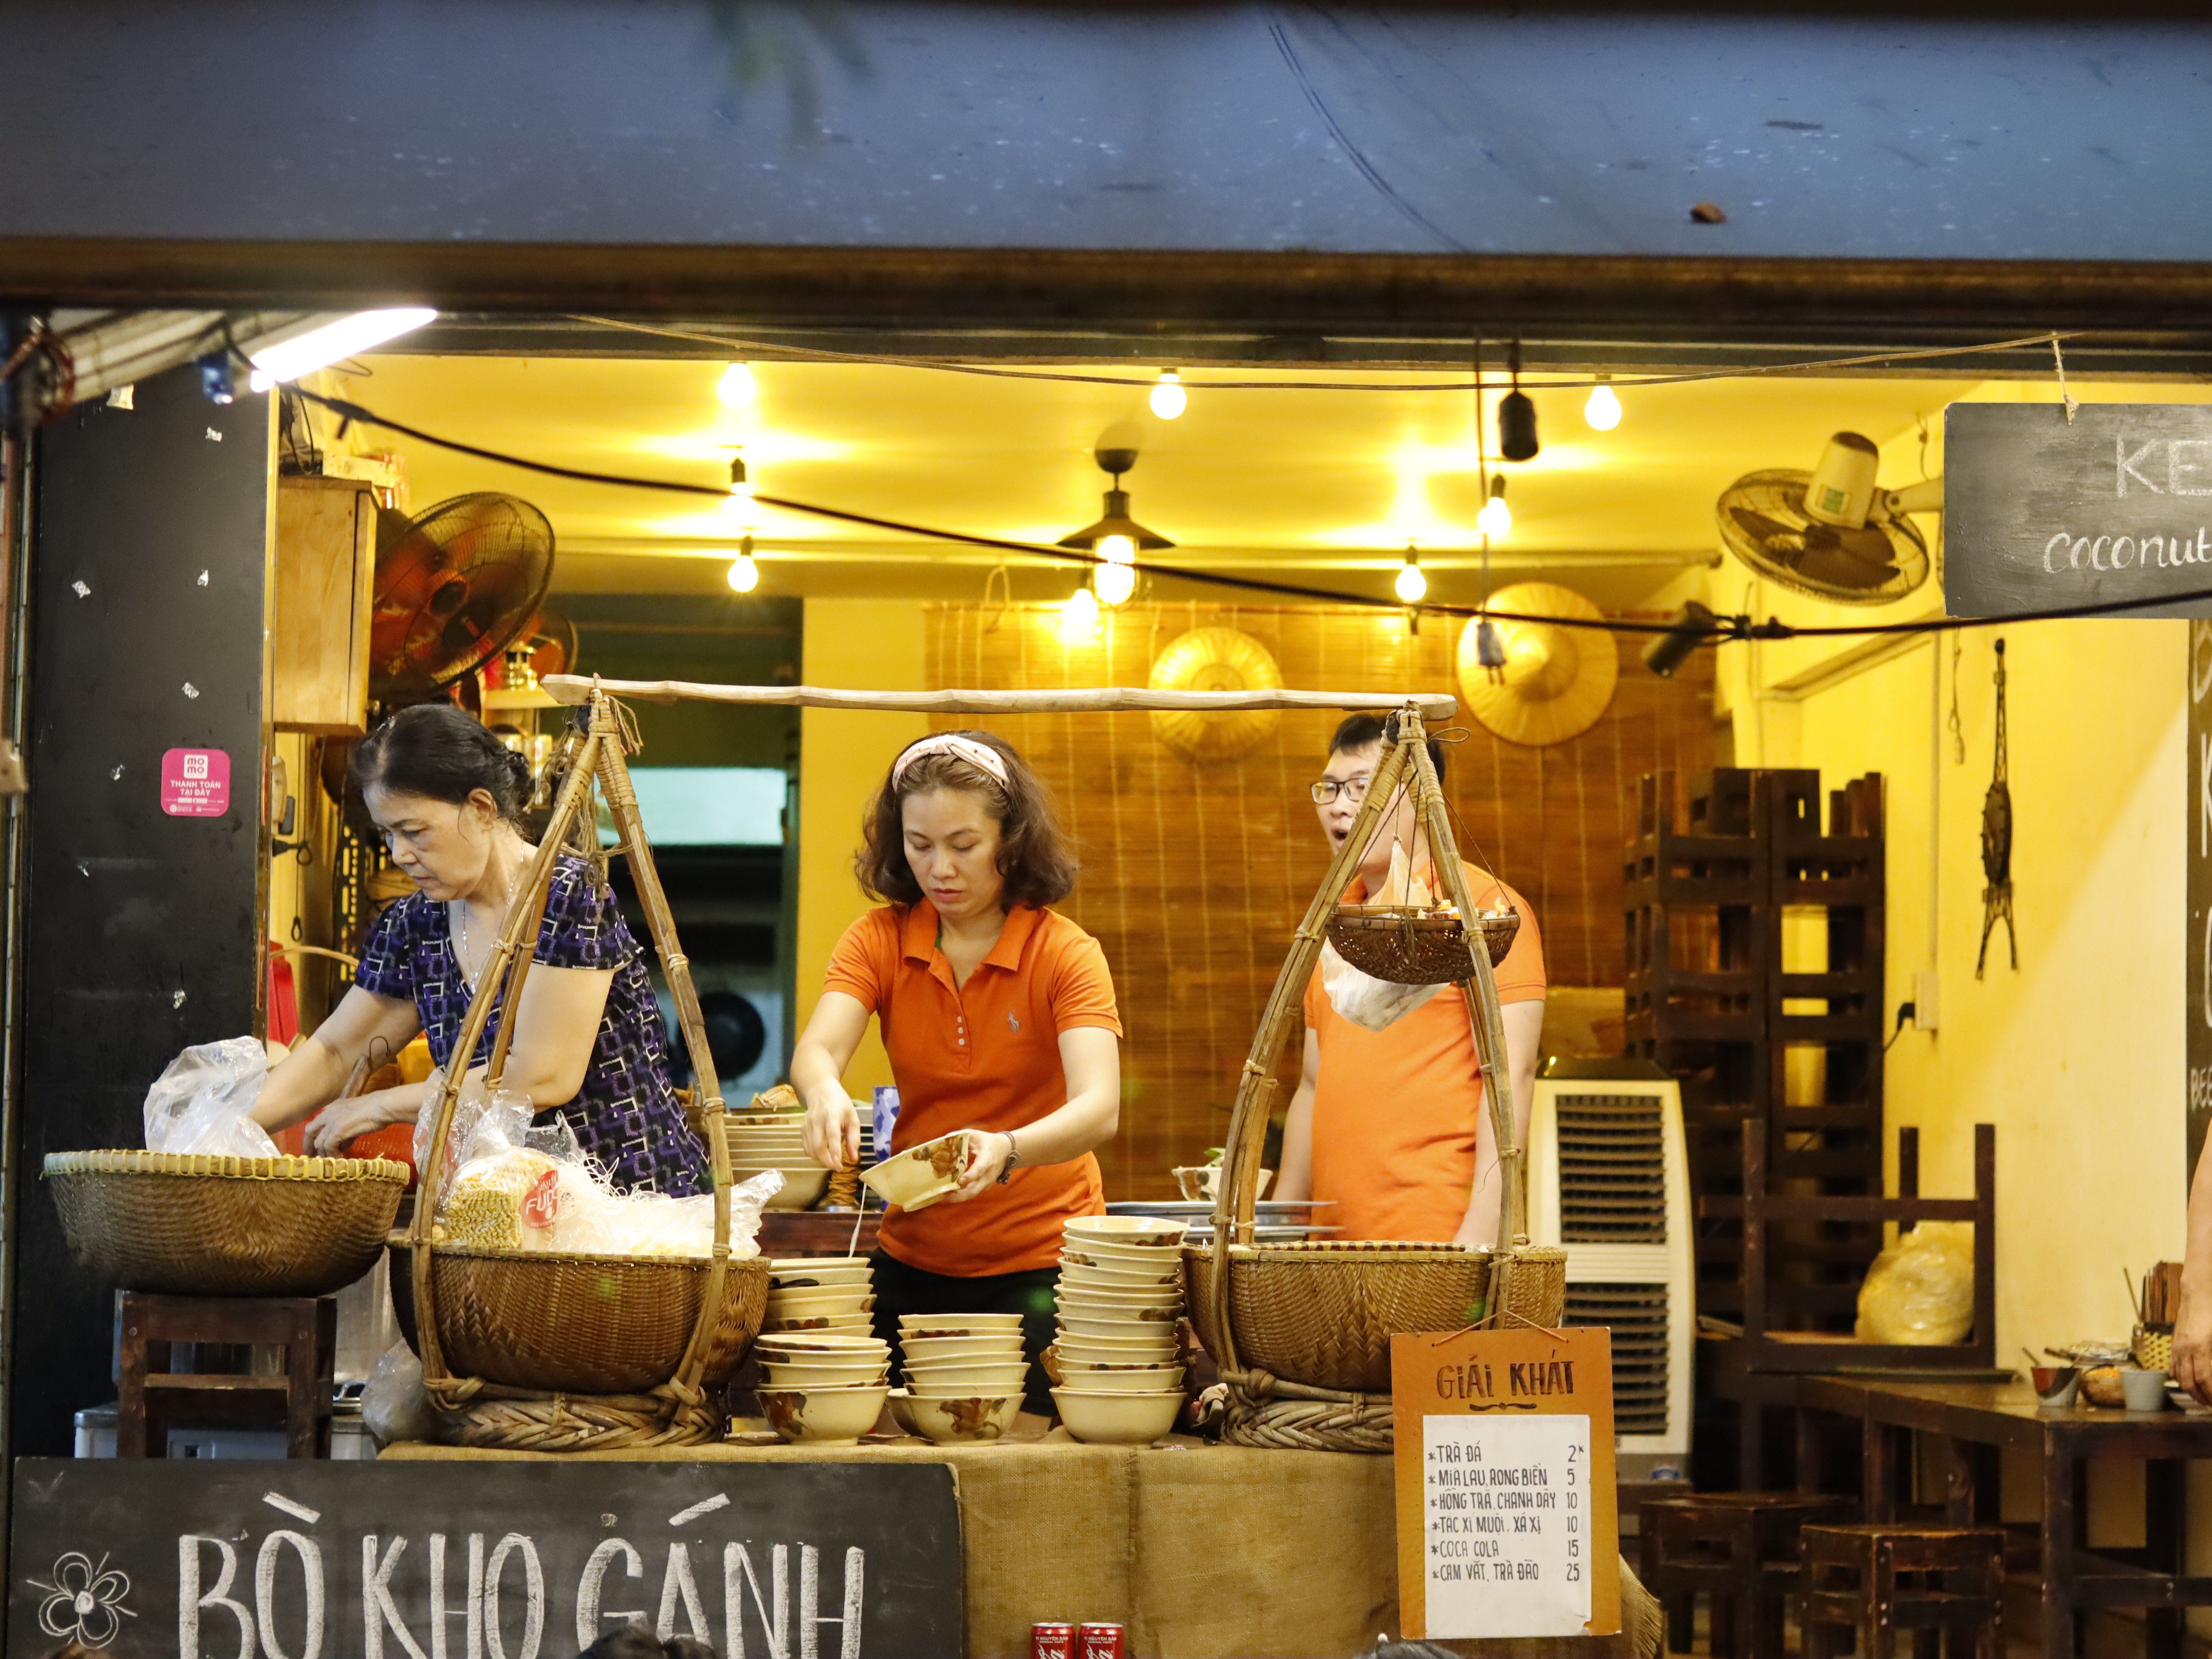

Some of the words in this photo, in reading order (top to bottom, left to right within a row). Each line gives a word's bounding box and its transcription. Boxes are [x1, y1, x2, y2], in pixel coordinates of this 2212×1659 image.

[199, 781, 221, 789] TOÁN
[1510, 1349, 1575, 1396] KHÁT
[1436, 1441, 1461, 1463] TRÀ
[1466, 1440, 1481, 1462] ĐÁ
[1490, 1468, 1519, 1486] RONG
[1522, 1462, 1547, 1486] BIỂN
[1567, 1468, 1575, 1486] 5
[1439, 1487, 1467, 1510] HỒNG
[1497, 1492, 1533, 1509] CHANH
[1536, 1488, 1556, 1509] DÂY
[1565, 1491, 1578, 1509] 10
[1513, 1512, 1527, 1533] XÁ
[1566, 1516, 1578, 1533] 10
[1440, 1540, 1468, 1558] COCA
[1474, 1540, 1499, 1557] COLA
[1568, 1539, 1578, 1557] 15
[179, 1492, 325, 1659] BÒ
[363, 1532, 545, 1659] KHO
[576, 1493, 865, 1659] GÁNH
[1441, 1564, 1461, 1581] CAM
[1493, 1560, 1514, 1581] TRÀ
[1566, 1563, 1580, 1581] 25
